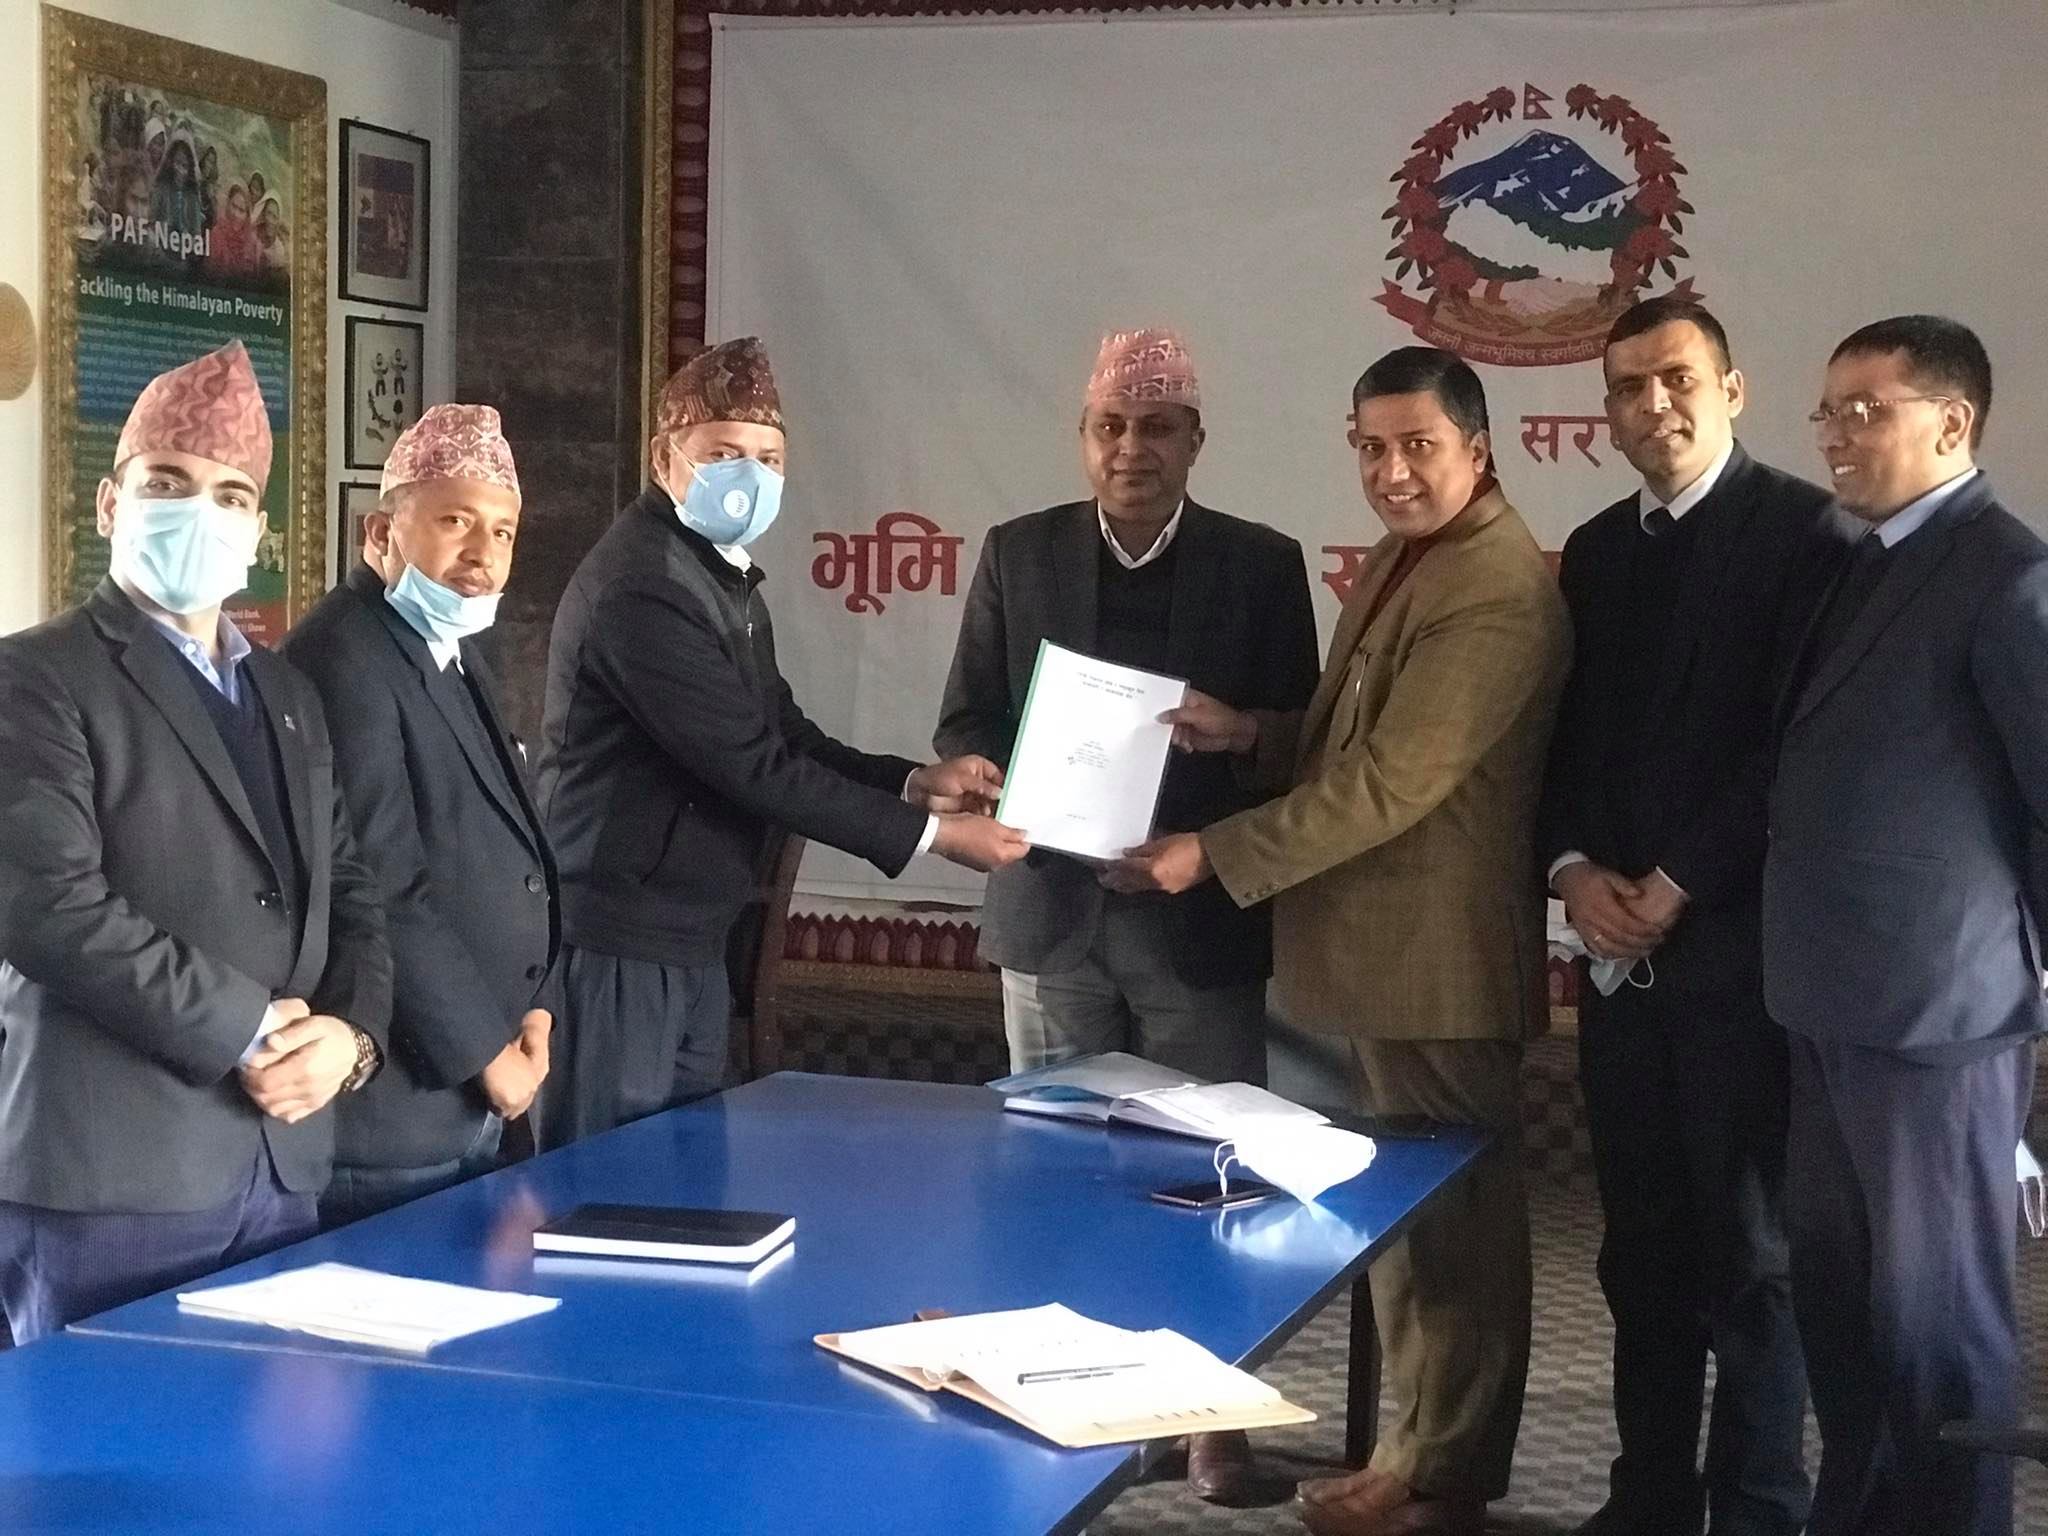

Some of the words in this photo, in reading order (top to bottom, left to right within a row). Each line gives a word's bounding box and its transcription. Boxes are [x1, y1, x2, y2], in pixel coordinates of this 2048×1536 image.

[111, 212, 149, 245] PAF
[154, 221, 210, 259] Nepal
[77, 273, 132, 305] ackling
[136, 282, 159, 305] the
[162, 286, 232, 317] Himalayan
[235, 297, 283, 326] Poverty
[811, 511, 965, 616] भूमि
